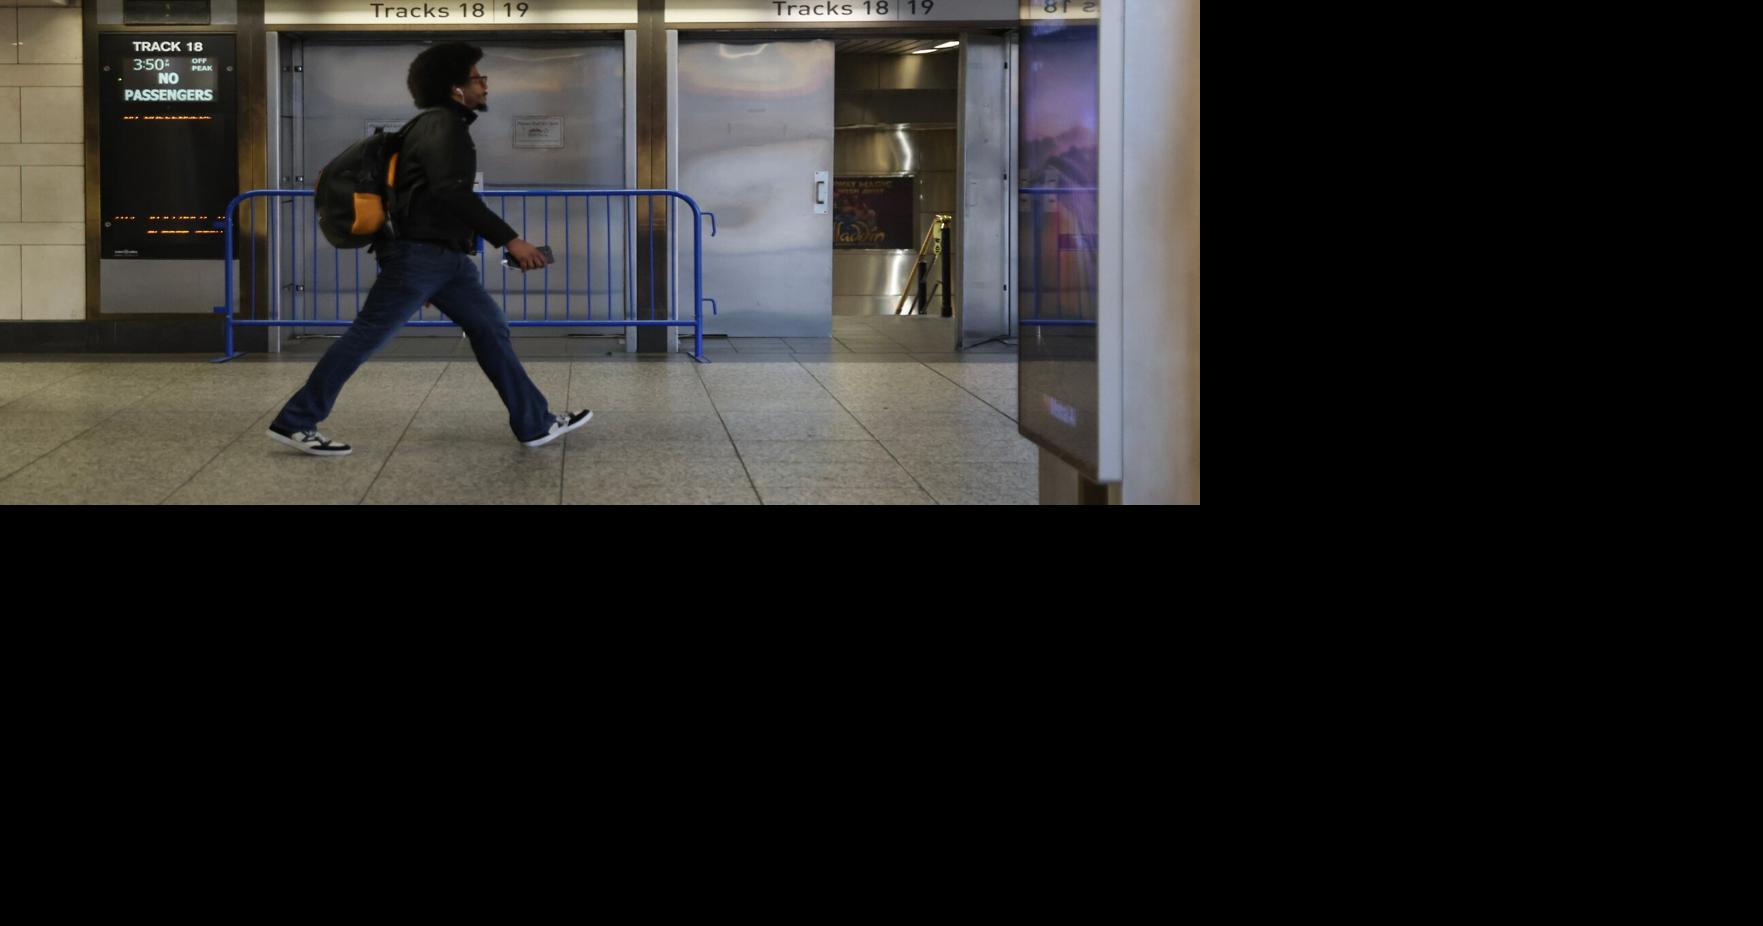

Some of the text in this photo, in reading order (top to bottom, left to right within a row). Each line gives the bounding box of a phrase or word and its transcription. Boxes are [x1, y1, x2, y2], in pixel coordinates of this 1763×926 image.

[370, 2, 529, 18] Tracks 18 19
[772, 0, 934, 16] Tracks 18 19
[132, 41, 203, 52] TRACK 18
[158, 72, 179, 85] NO
[124, 89, 213, 101] PASSENGERS
